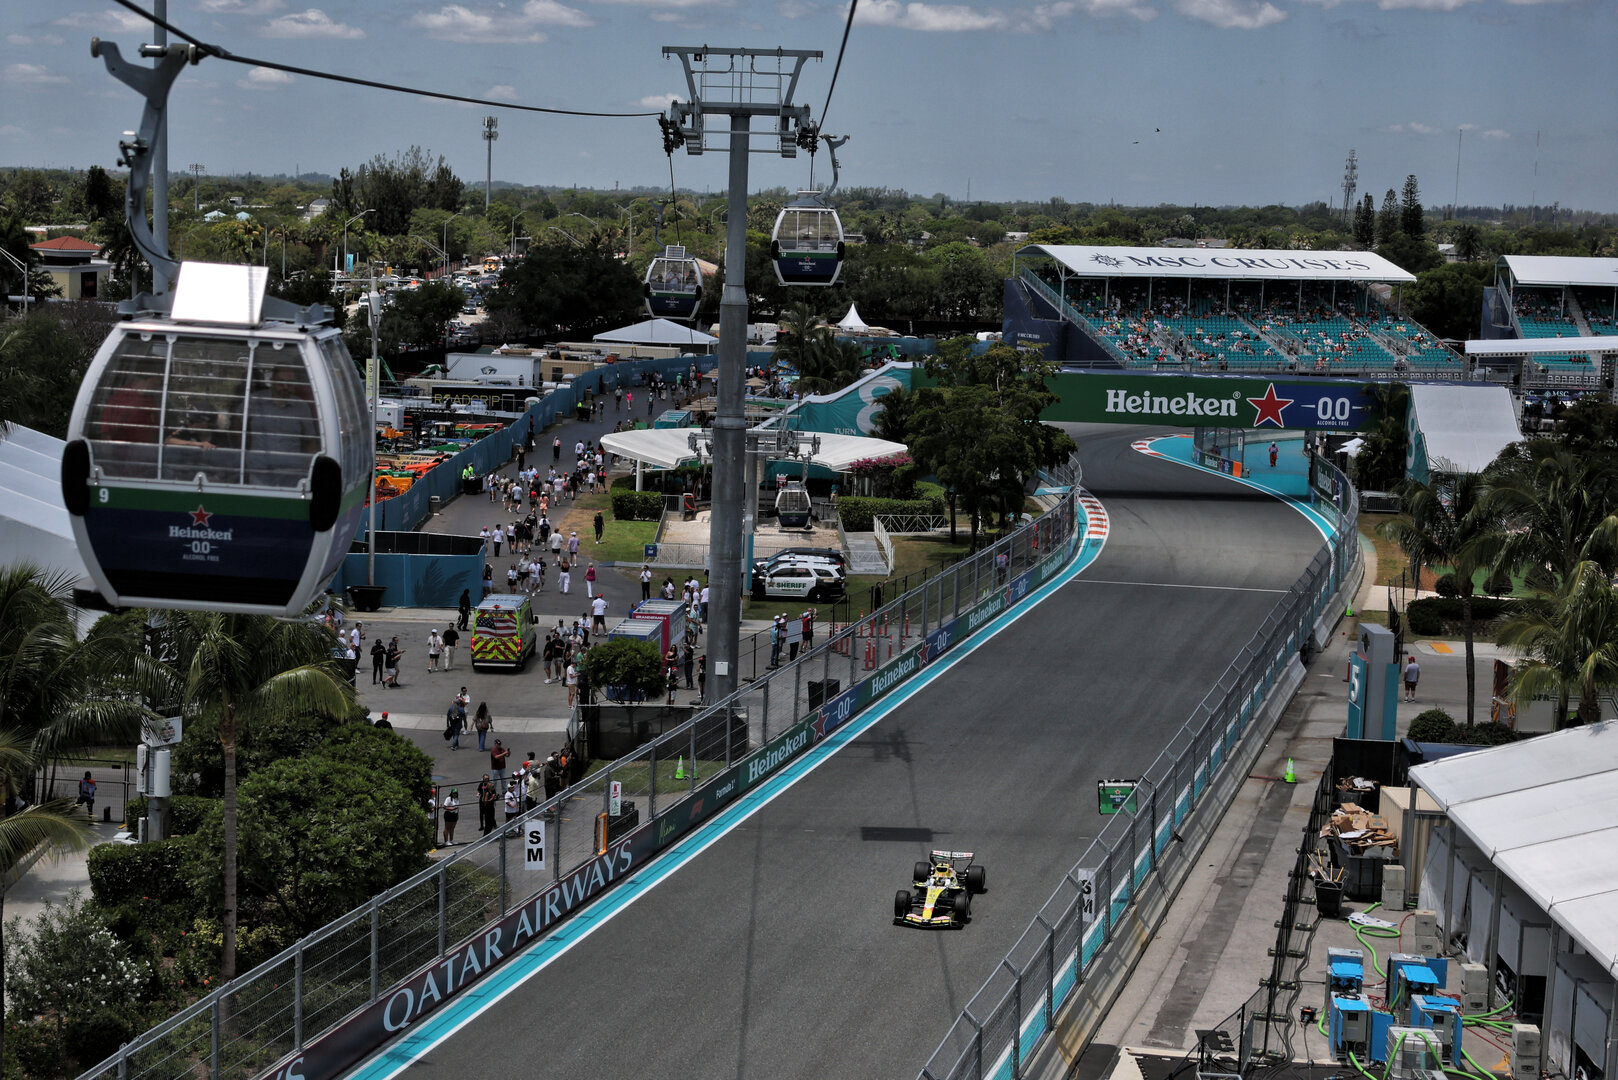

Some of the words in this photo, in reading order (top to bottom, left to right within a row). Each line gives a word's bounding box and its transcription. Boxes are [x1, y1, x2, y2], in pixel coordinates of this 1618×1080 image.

[1124, 256, 1206, 267] MSC
[1211, 257, 1371, 271] CRUISES
[1317, 397, 1350, 420] 0.0
[833, 427, 857, 435] TURN
[99, 488, 109, 503] 9
[168, 525, 232, 540] Heineken
[968, 598, 1001, 630] Heineken
[872, 656, 915, 697] Heineken
[1350, 664, 1360, 702] 5
[748, 729, 807, 783] Heineken
[384, 927, 504, 1032] QATAR
[512, 840, 633, 948] AIRWAYS
